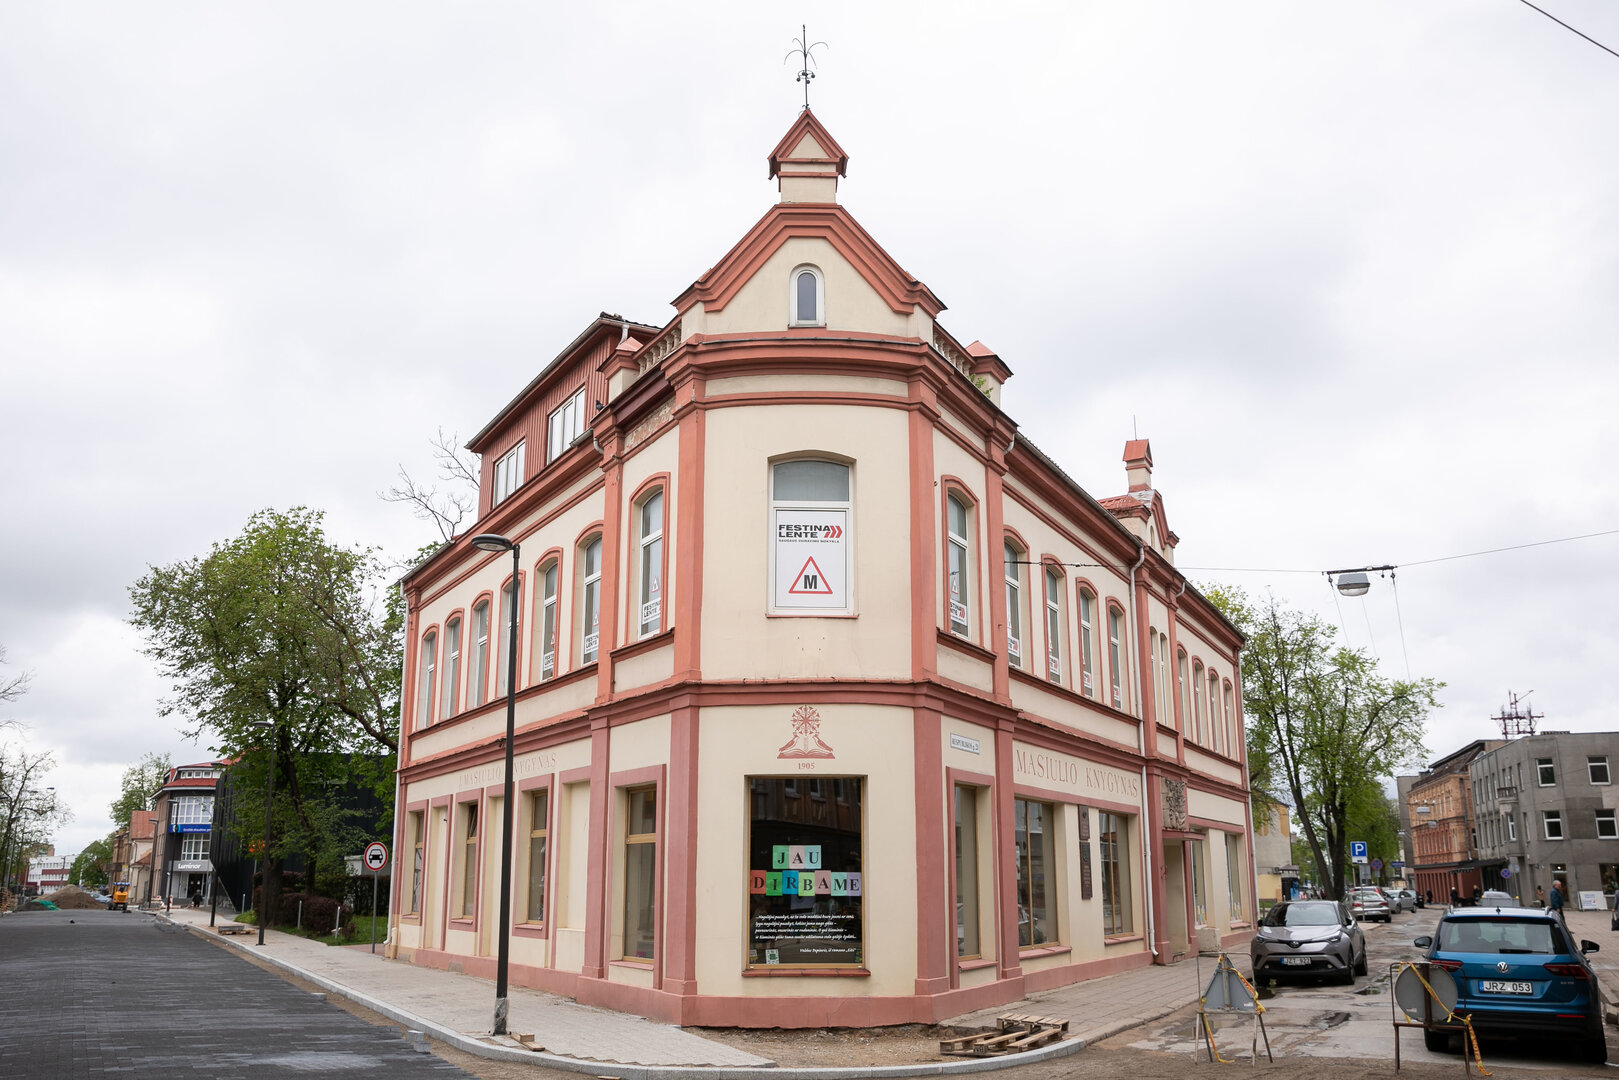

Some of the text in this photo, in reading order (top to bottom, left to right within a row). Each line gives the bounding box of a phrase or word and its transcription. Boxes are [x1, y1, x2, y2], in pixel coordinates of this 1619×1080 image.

[778, 531, 818, 539] LENTE
[804, 575, 817, 589] M
[513, 753, 556, 774] NYGYNAS
[798, 762, 815, 770] 1905
[1016, 750, 1138, 799] MASIULIO KNYGYNAS
[1355, 843, 1365, 856] P
[777, 851, 819, 864] JAU
[754, 877, 859, 891] DIRBAME
[1485, 982, 1506, 991] JRZ
[1512, 983, 1531, 992] 053
